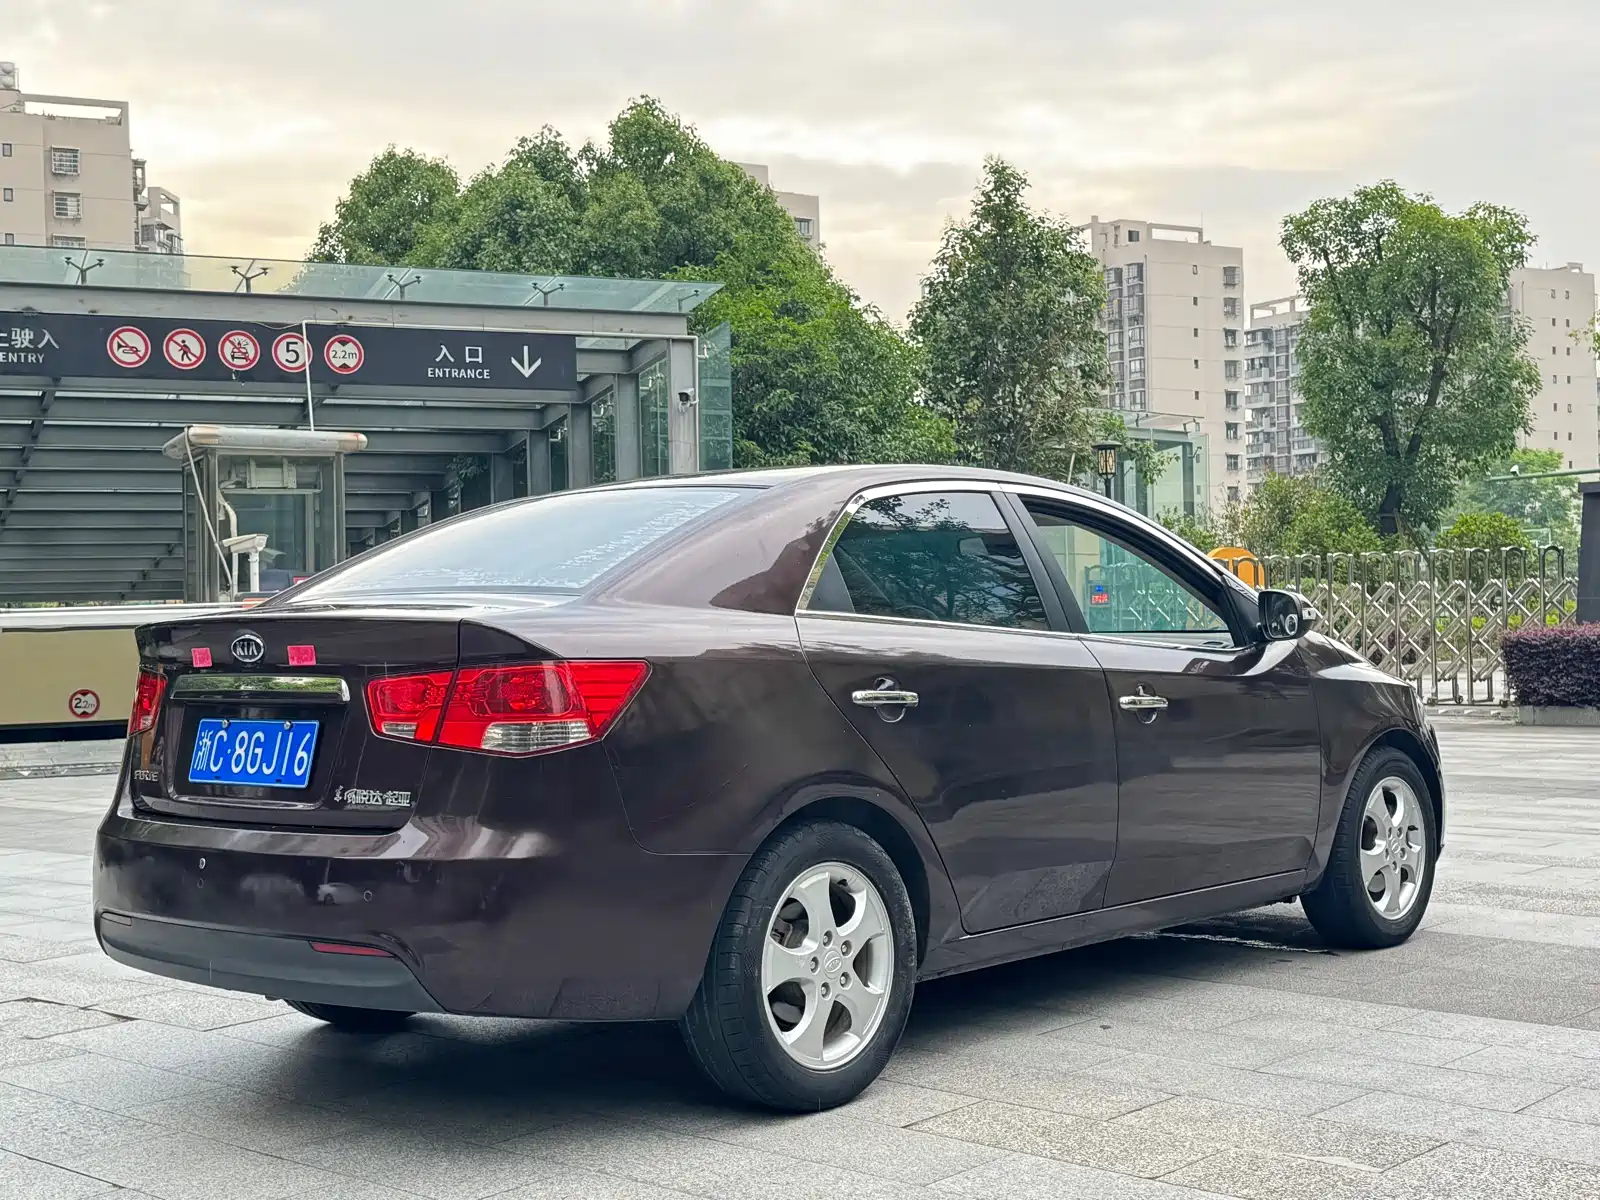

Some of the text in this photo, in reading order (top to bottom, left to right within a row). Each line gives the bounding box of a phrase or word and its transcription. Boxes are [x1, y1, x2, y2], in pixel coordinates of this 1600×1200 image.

[0, 352, 44, 363] ENTRY
[285, 341, 300, 364] 5
[331, 349, 357, 360] 2.2m
[435, 344, 483, 364] 入口
[427, 367, 490, 379] ENTRANCE
[235, 641, 258, 656] KIA
